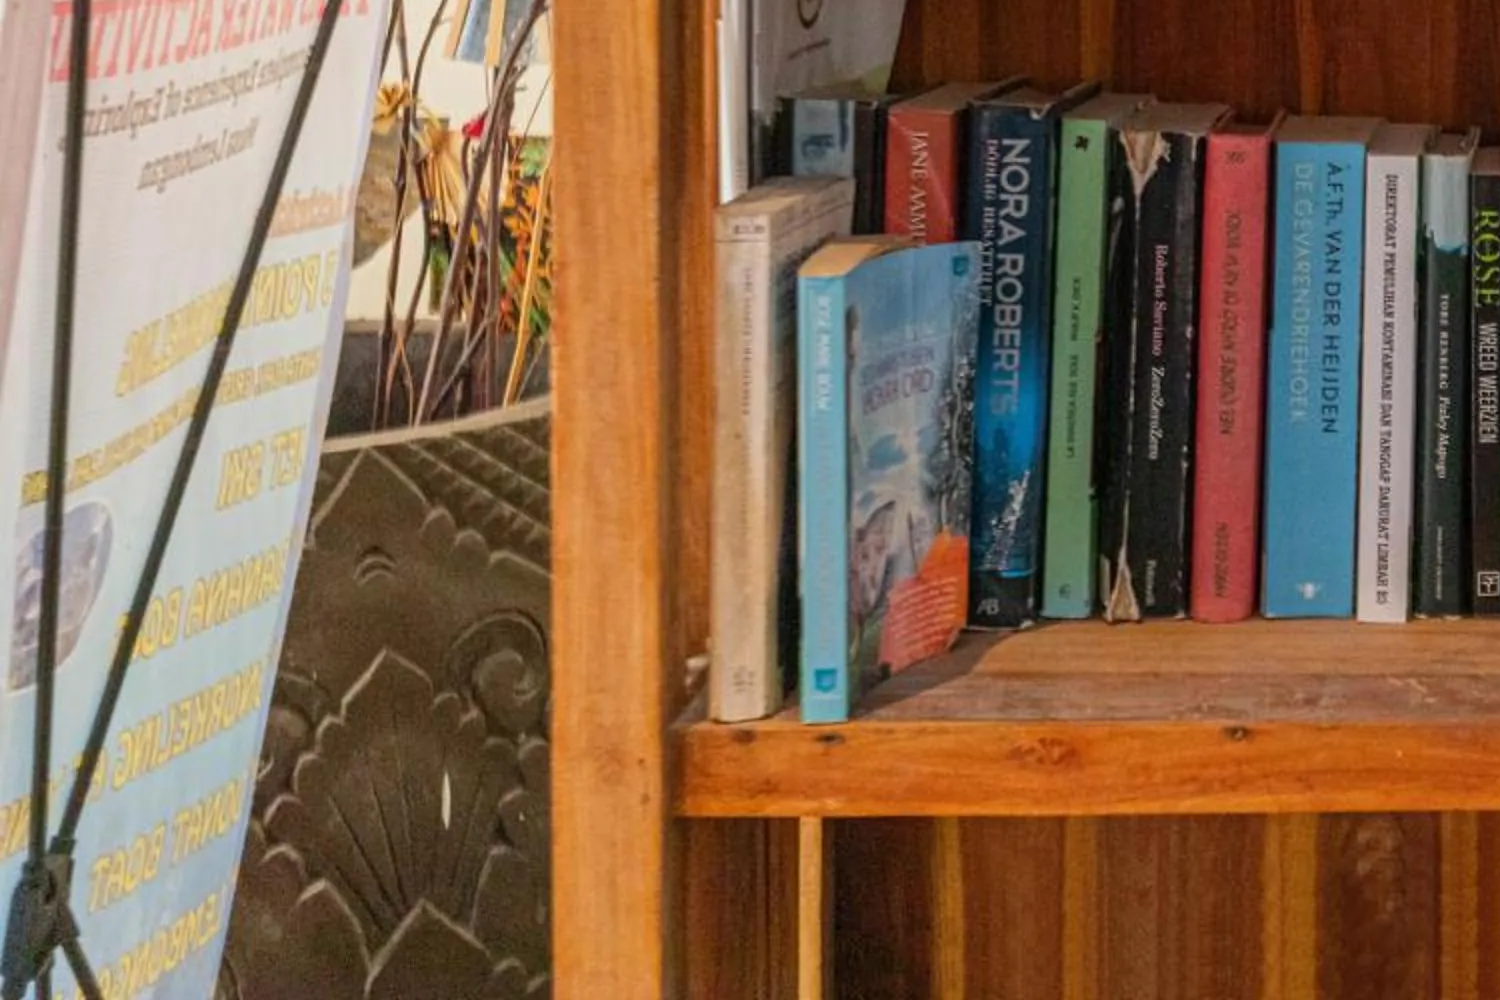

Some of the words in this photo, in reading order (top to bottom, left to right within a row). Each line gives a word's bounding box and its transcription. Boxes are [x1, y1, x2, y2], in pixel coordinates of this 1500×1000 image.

[908, 130, 929, 181] JANE
[1293, 162, 1315, 193] DE
[996, 138, 1031, 244] NORA
[1322, 162, 1345, 226] A.F.Th.
[1382, 173, 1400, 249] DIREKTORAT
[1152, 243, 1169, 299] Roberto
[1323, 230, 1343, 275] VAN
[1321, 281, 1344, 326] DER
[1382, 251, 1399, 318] PEMULIHAN
[990, 253, 1026, 416] ROBERTS
[1152, 301, 1169, 357] Saviano
[1479, 322, 1499, 371] WREED
[1320, 334, 1341, 434] HEIJDEN
[1381, 321, 1397, 400] KONTAMINASI
[1148, 365, 1166, 461] ZeroZeroZero
[1379, 403, 1395, 428] DAN
[1479, 375, 1499, 444] WEERZIEN
[1378, 429, 1395, 482] TANGGAP
[1377, 484, 1394, 539] DARURAT
[1376, 542, 1392, 586] LIMBAH
